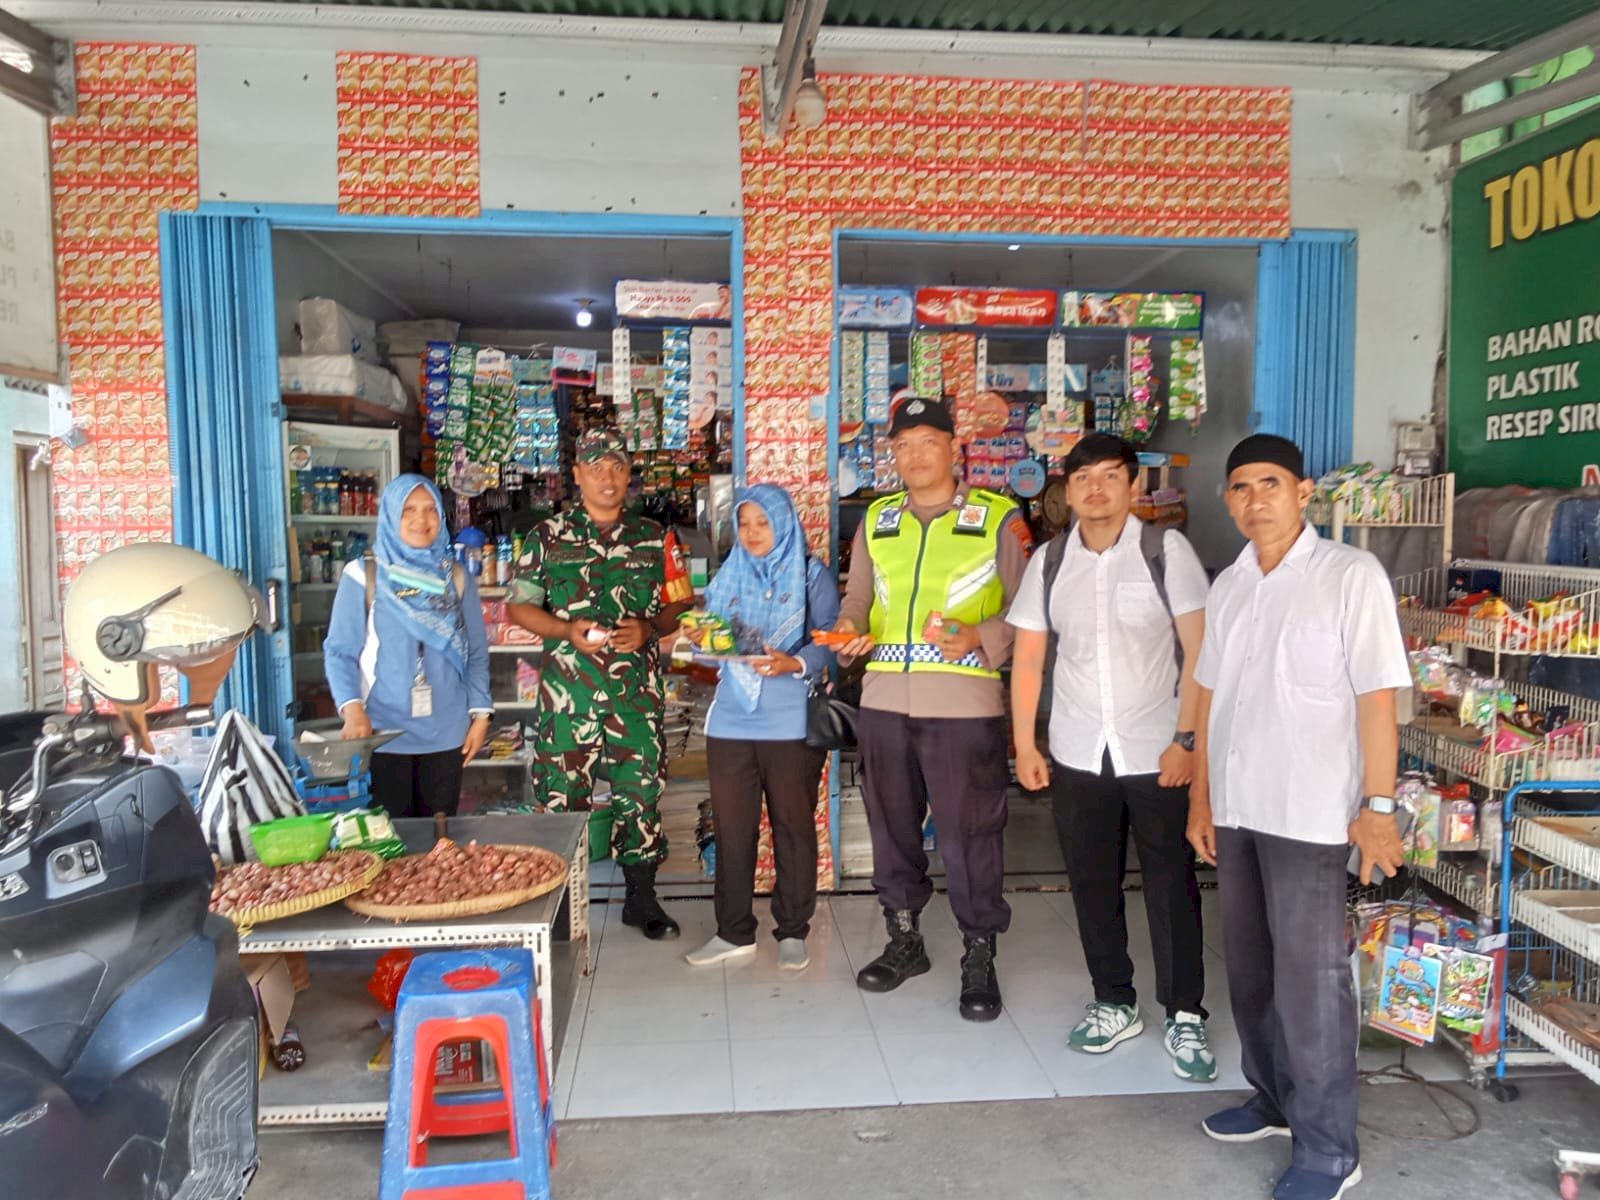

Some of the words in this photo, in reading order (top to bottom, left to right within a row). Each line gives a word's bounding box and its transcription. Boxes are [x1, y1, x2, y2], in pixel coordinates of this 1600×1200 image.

[1484, 139, 1600, 249] TOKO
[1488, 319, 1571, 362] BAHAN
[1487, 361, 1580, 402] PLASTIK
[1486, 408, 1554, 441] RESEP
